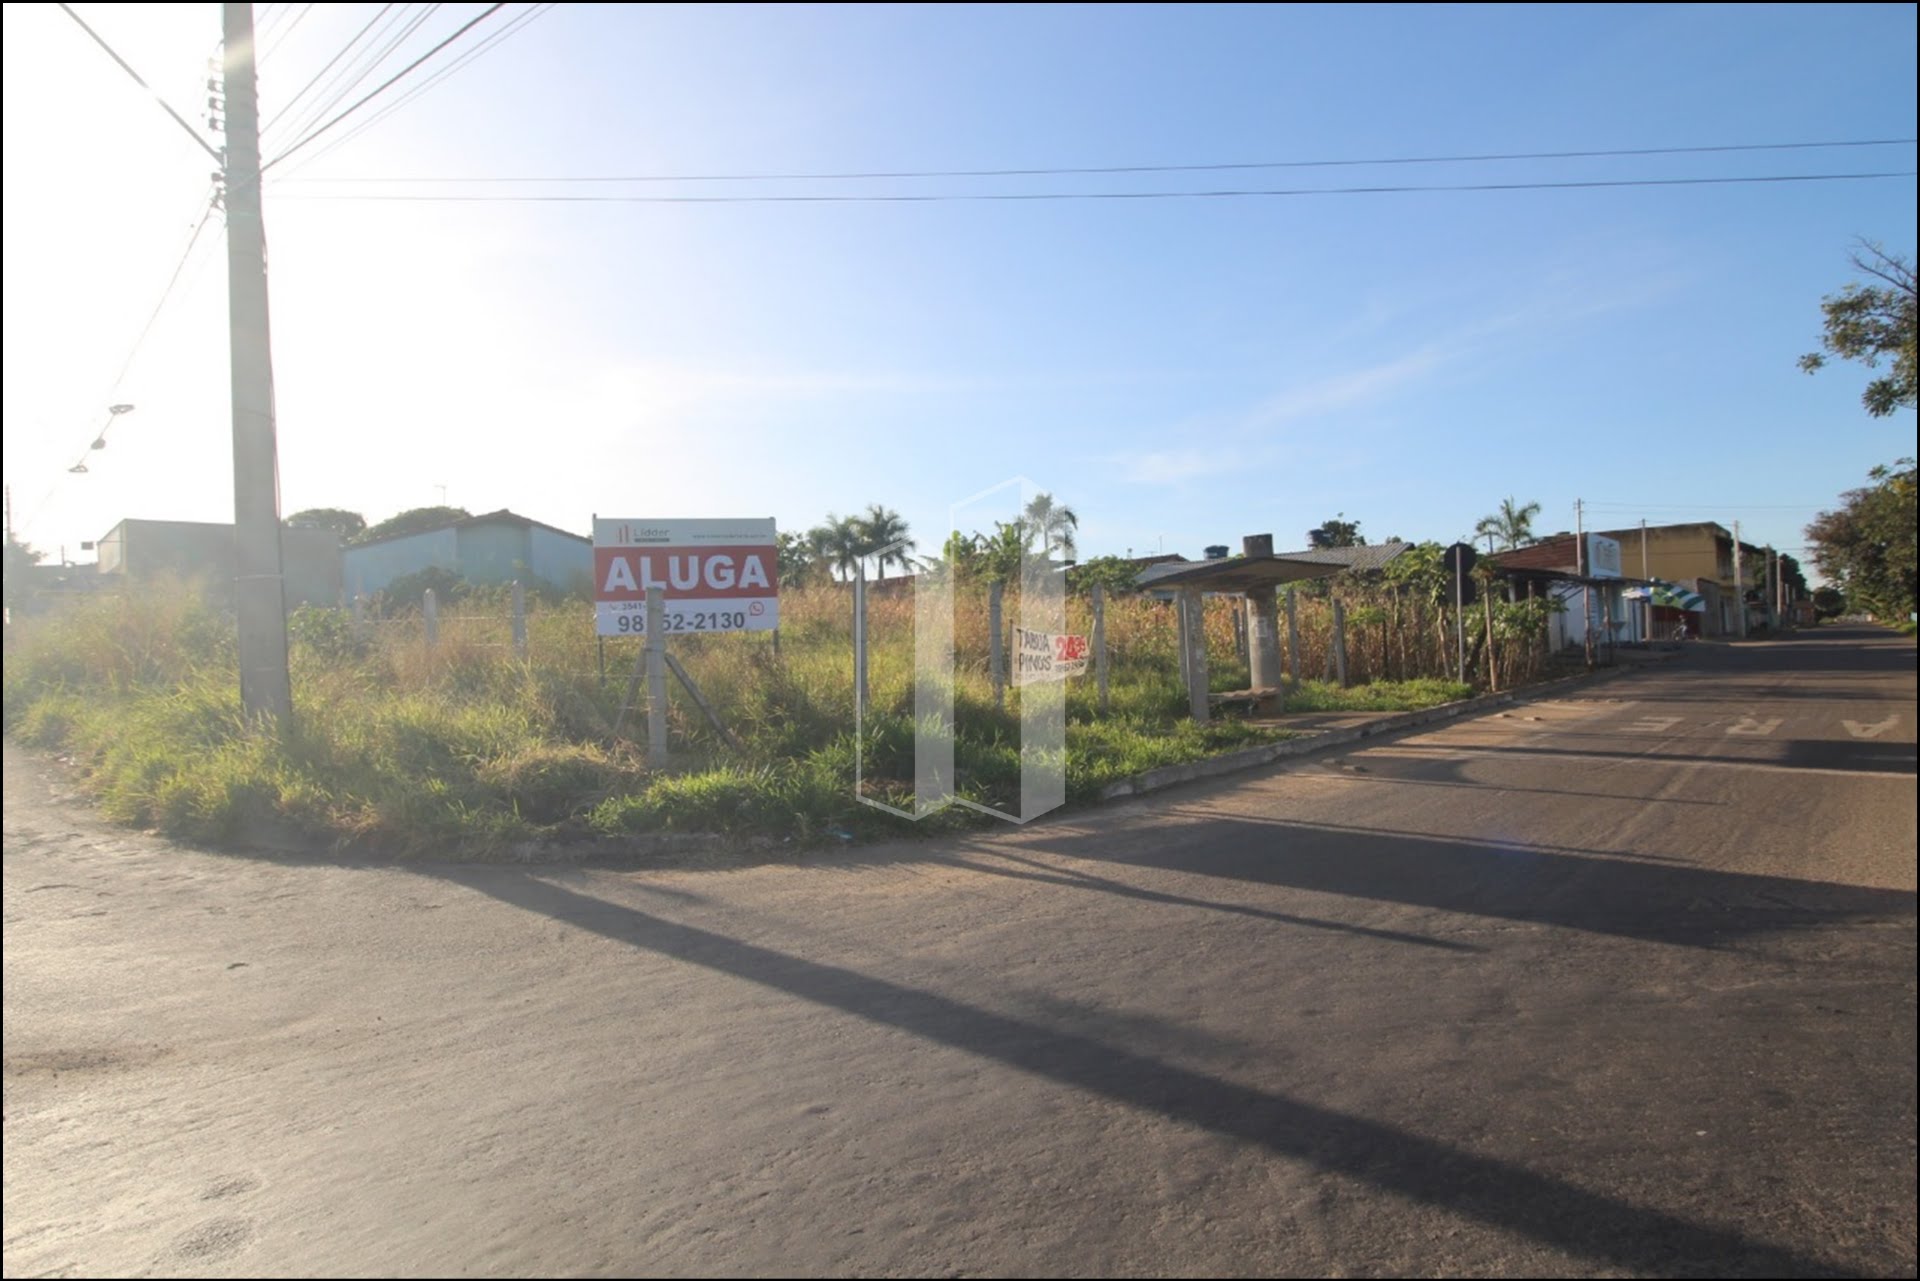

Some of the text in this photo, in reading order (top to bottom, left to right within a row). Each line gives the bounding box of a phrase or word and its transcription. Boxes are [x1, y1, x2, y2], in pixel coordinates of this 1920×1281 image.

[605, 555, 769, 592] ALUGA
[618, 612, 745, 632] 9852-2130
[1018, 653, 1052, 672] PINUS
